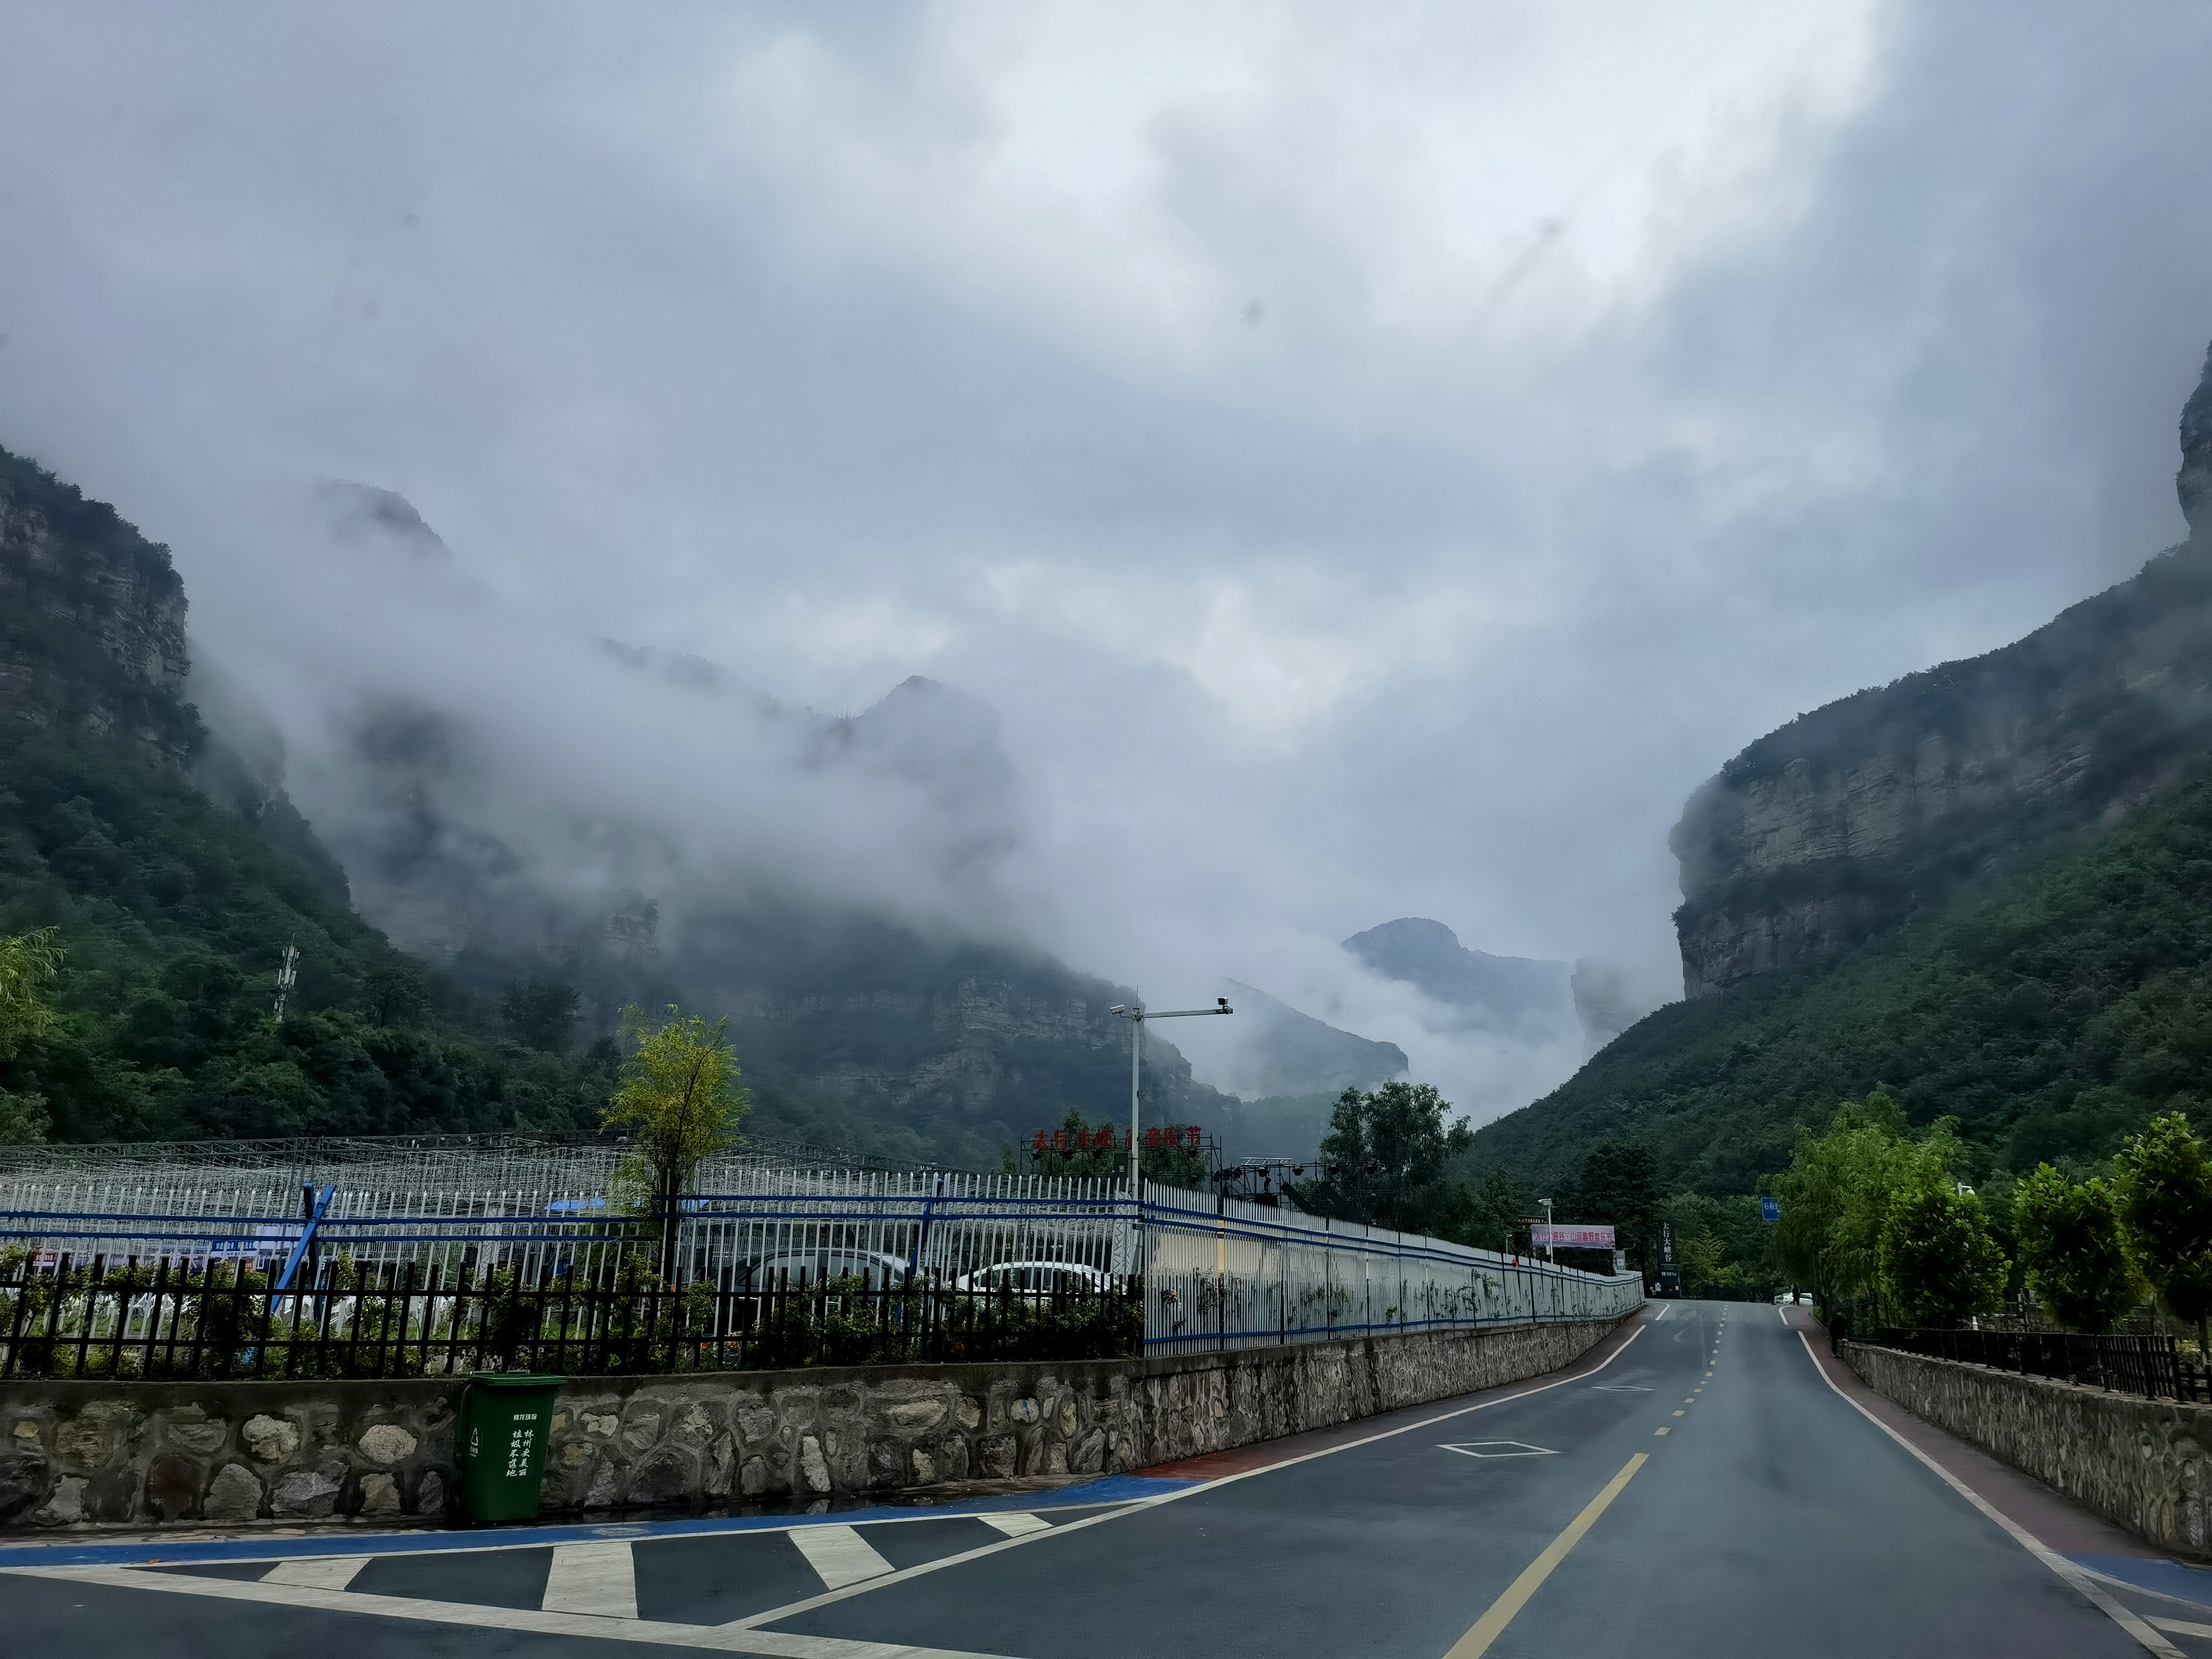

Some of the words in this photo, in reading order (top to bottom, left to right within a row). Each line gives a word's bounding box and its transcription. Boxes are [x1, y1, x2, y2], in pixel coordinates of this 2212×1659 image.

[1663, 1222, 1673, 1262] 太行大峡谷
[506, 1429, 522, 1476] 垃圾不落地
[518, 1429, 534, 1476] 林州更美丽
